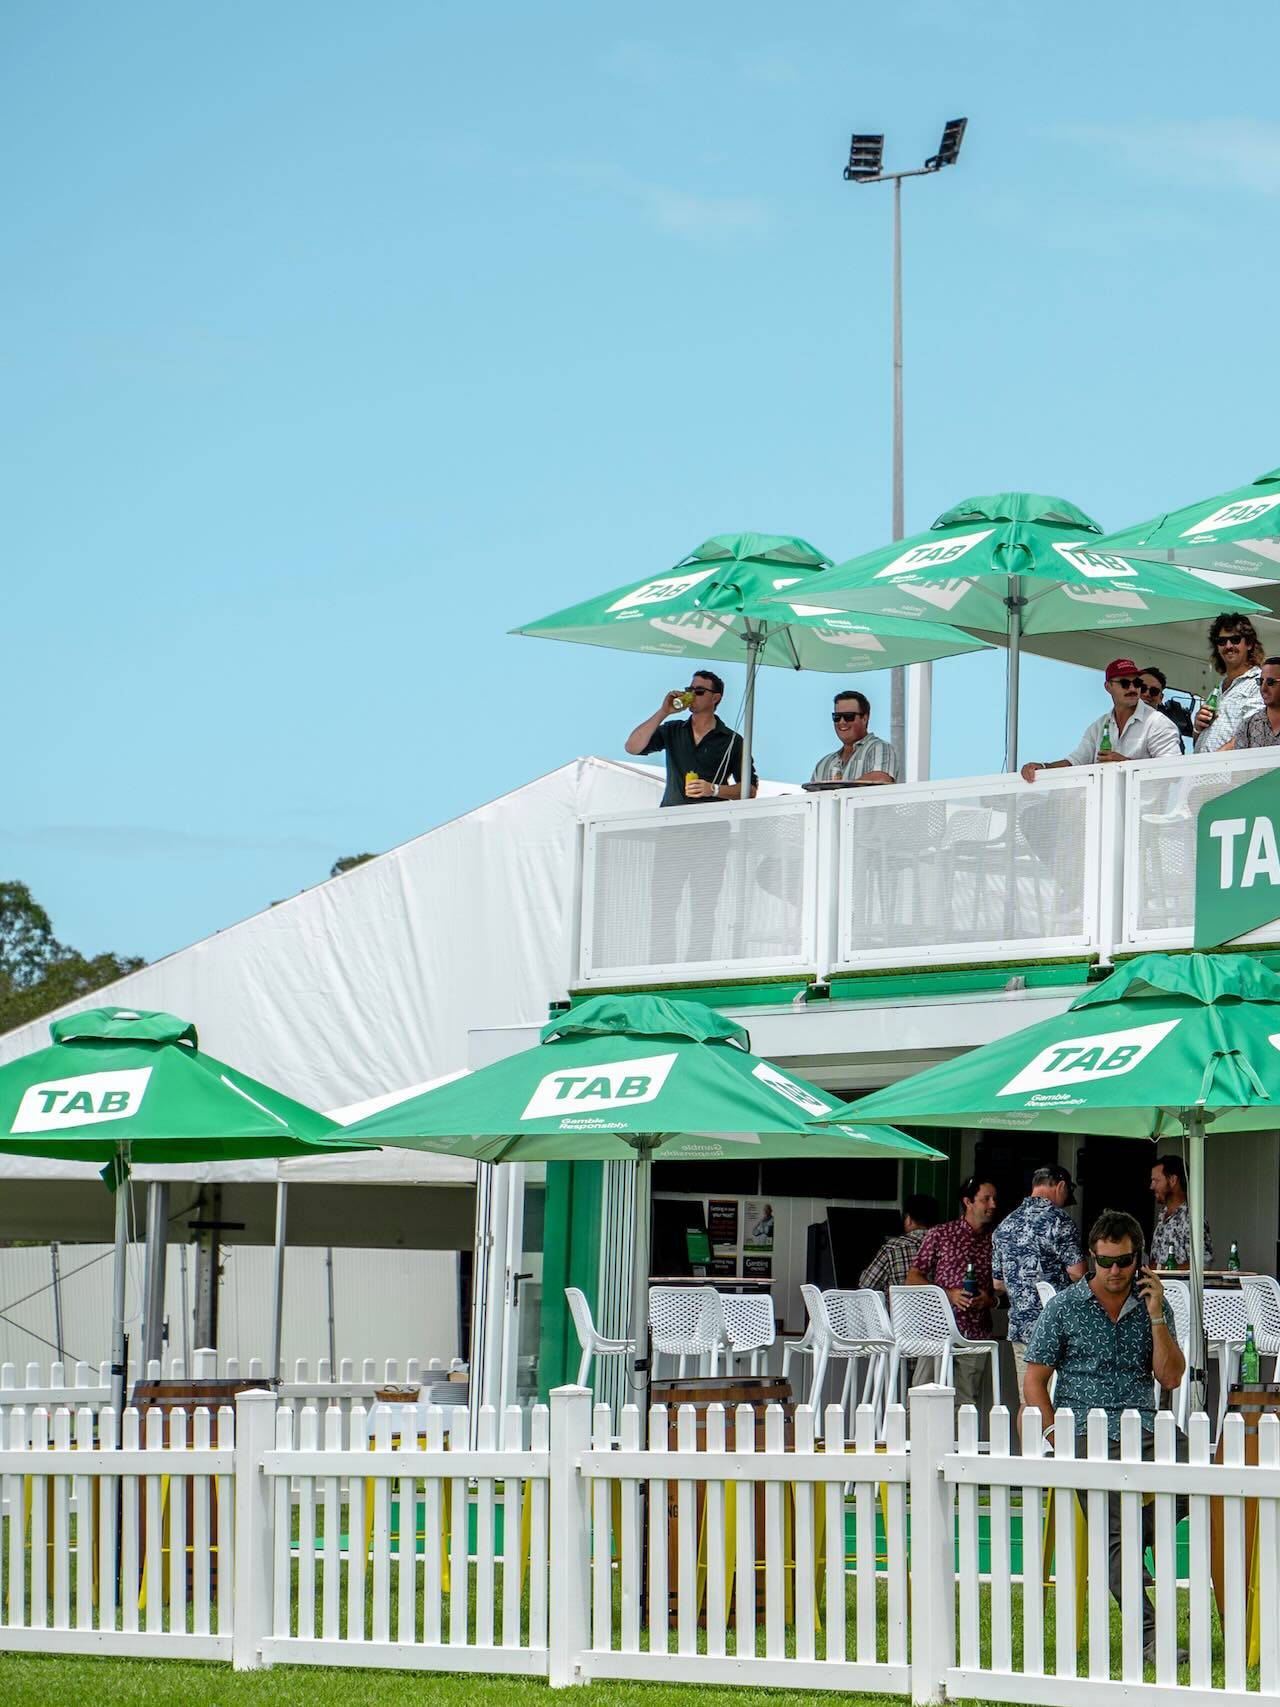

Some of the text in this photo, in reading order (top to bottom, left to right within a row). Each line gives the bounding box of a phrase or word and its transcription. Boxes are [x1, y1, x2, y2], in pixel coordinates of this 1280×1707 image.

[1214, 503, 1273, 523] TAB
[905, 544, 967, 564] TAB
[637, 582, 691, 600] TAB
[1041, 1045, 1142, 1073] TAB
[553, 1076, 652, 1100] TAB
[38, 1090, 131, 1114] TAB
[558, 1122, 629, 1131] Responsibly.
